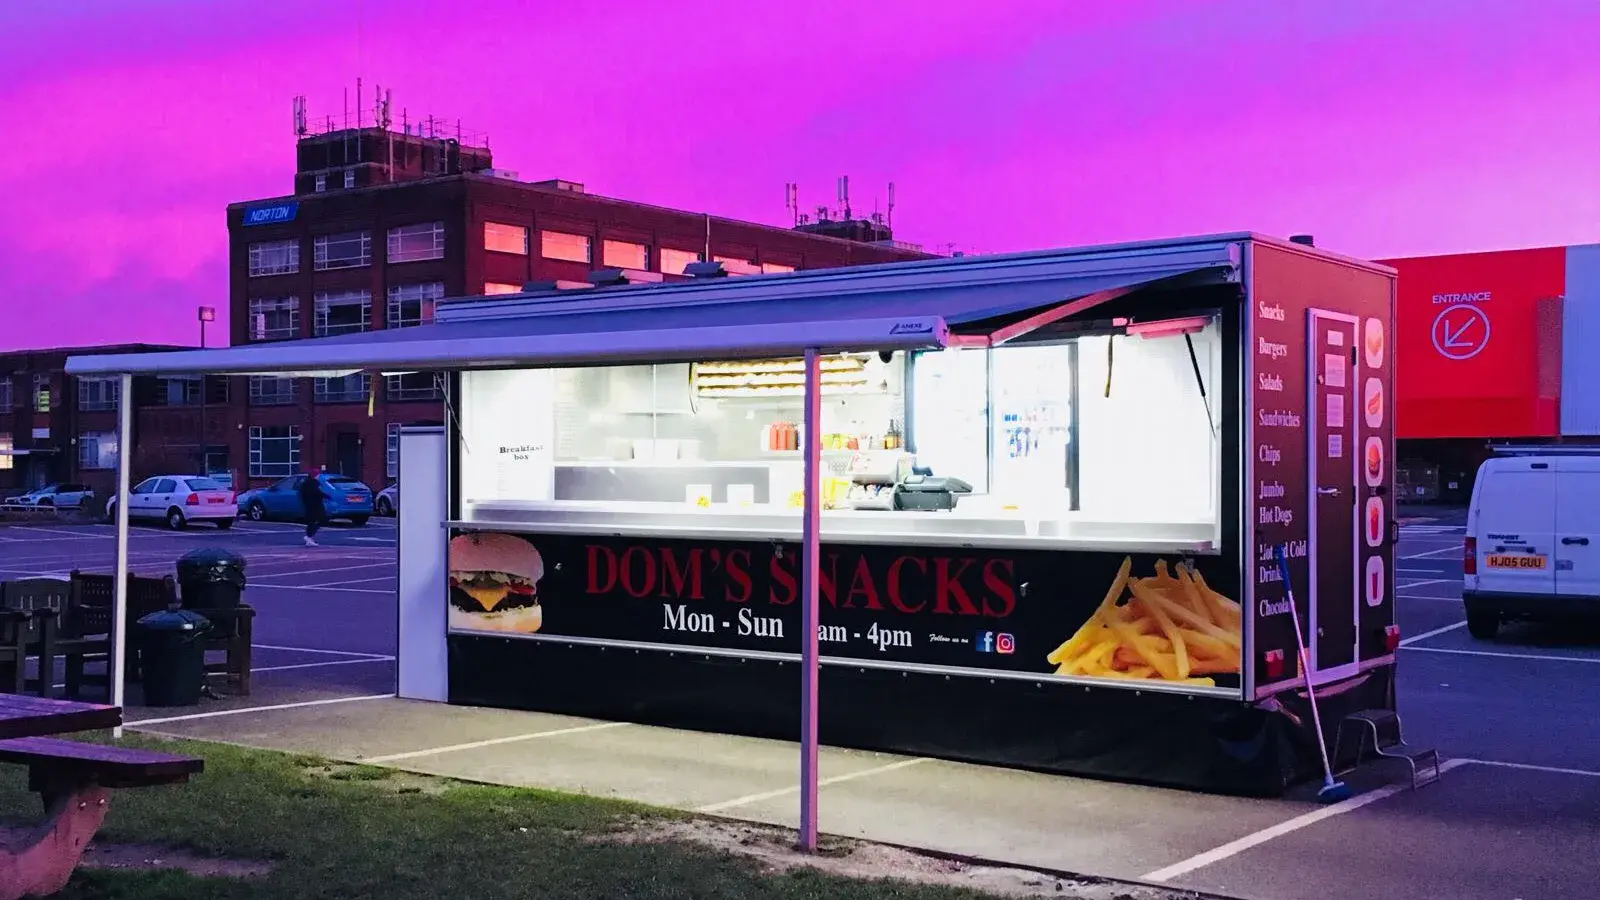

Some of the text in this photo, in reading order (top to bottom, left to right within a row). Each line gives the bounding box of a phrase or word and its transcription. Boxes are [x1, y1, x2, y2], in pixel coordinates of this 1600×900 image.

[251, 207, 289, 221] NORTON
[1432, 292, 1491, 304] ENTRANCE
[1259, 301, 1284, 321] Snacks
[1259, 337, 1287, 360] Burgers
[1259, 373, 1283, 391] Salads
[1259, 409, 1300, 427] Sandwiches
[500, 445, 543, 453] Breakfast
[1259, 445, 1280, 466] Chips
[1259, 480, 1284, 499] Jumbo
[1260, 506, 1292, 526] Hot Dogs
[1290, 540, 1306, 557] Cold
[1491, 557, 1542, 567] HJ05 GUU
[585, 545, 1016, 618] DOM'S SNACKS
[1260, 565, 1284, 583] Drink
[663, 604, 715, 633] Mon
[738, 608, 784, 638] Sun
[867, 622, 912, 651] 4pm
[929, 634, 951, 642] Follow
